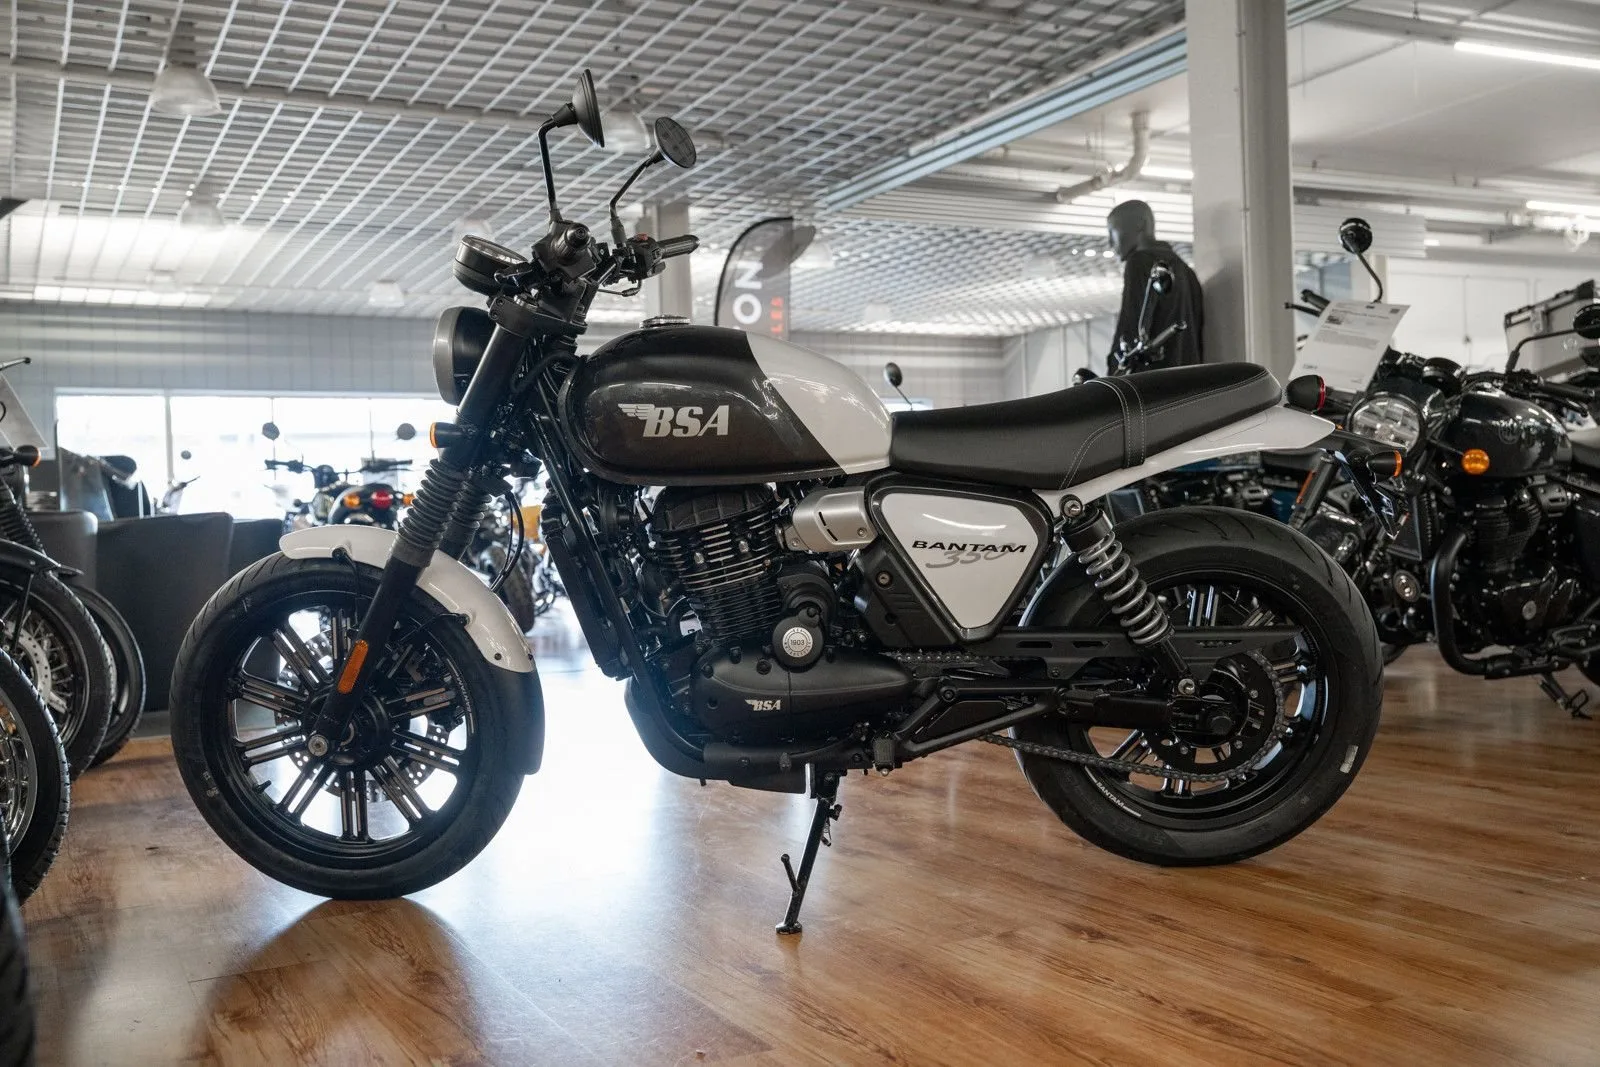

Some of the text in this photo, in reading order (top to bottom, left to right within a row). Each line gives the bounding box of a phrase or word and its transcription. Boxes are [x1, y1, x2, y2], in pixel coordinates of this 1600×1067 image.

[733, 261, 763, 329] ON
[642, 404, 729, 437] BSA
[912, 540, 1027, 553] BANTAM
[925, 543, 1016, 569] 350
[753, 699, 781, 711] BSA
[1096, 781, 1125, 808] BANTAM
